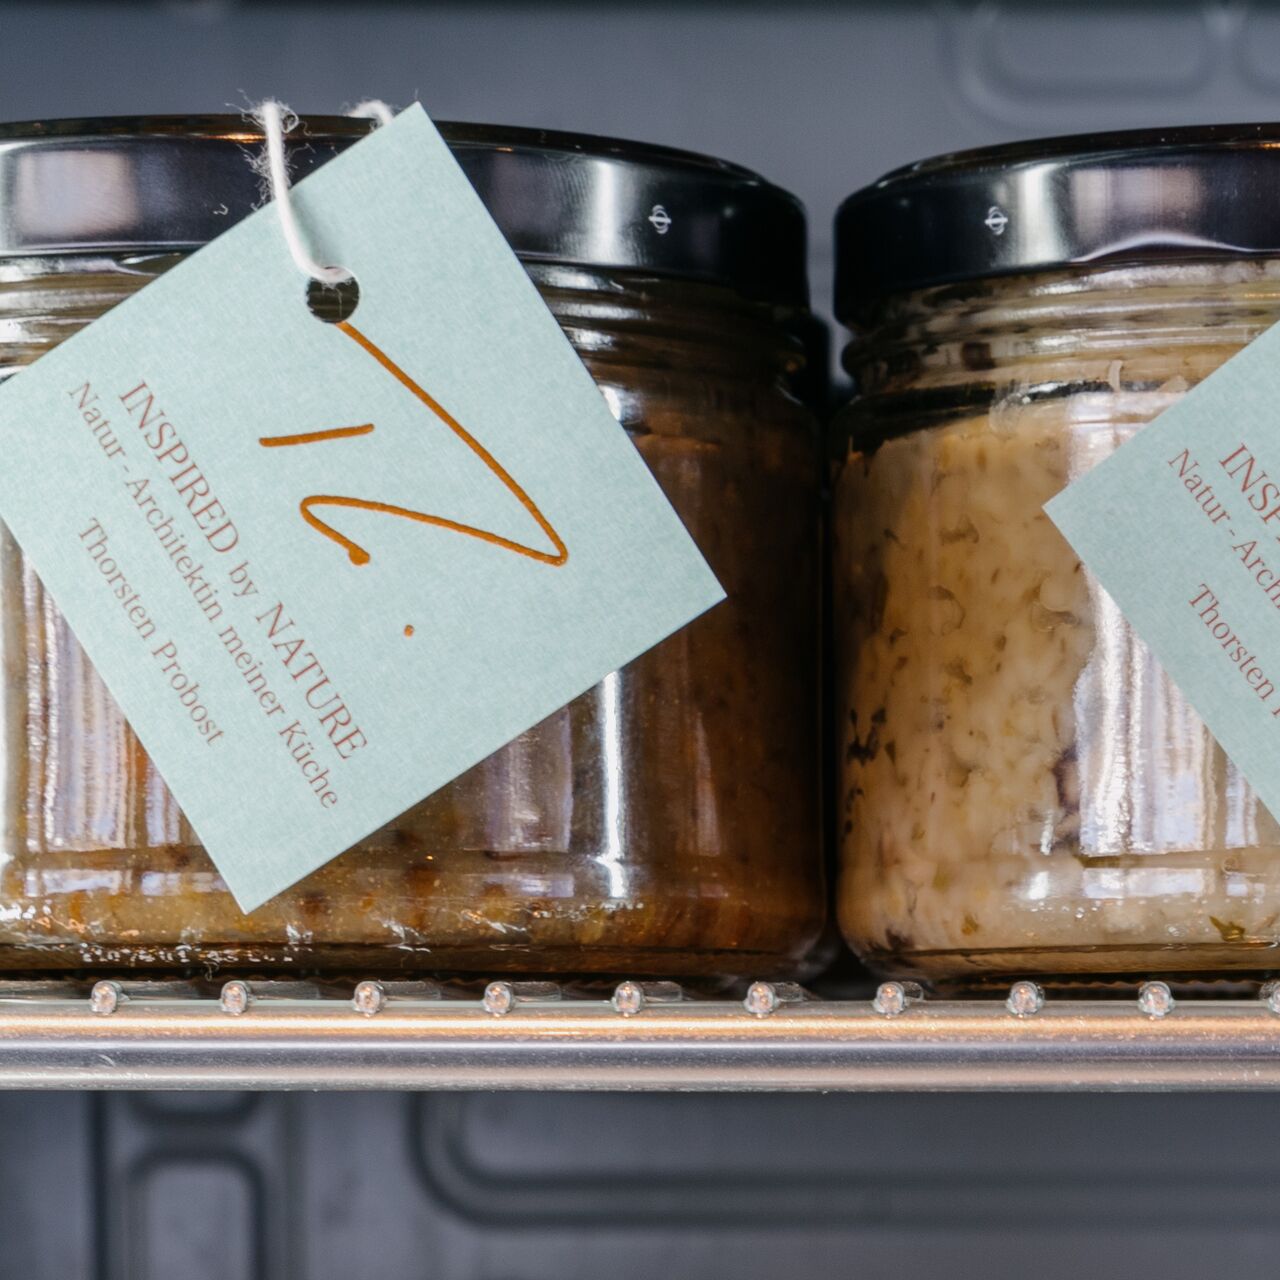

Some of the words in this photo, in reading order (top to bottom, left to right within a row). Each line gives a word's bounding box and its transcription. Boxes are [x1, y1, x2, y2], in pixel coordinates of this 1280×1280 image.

[69, 379, 126, 460] Natur
[125, 478, 225, 622] Architektin
[220, 624, 285, 717] meiner
[277, 720, 339, 808] Küche
[119, 381, 240, 553] INSPIRED
[228, 560, 258, 598] by
[255, 601, 369, 762] NATURE
[1167, 448, 1232, 526] Natur
[78, 517, 157, 640] Thorsten
[152, 641, 225, 745] Probost
[1188, 583, 1276, 702] Thorsten
